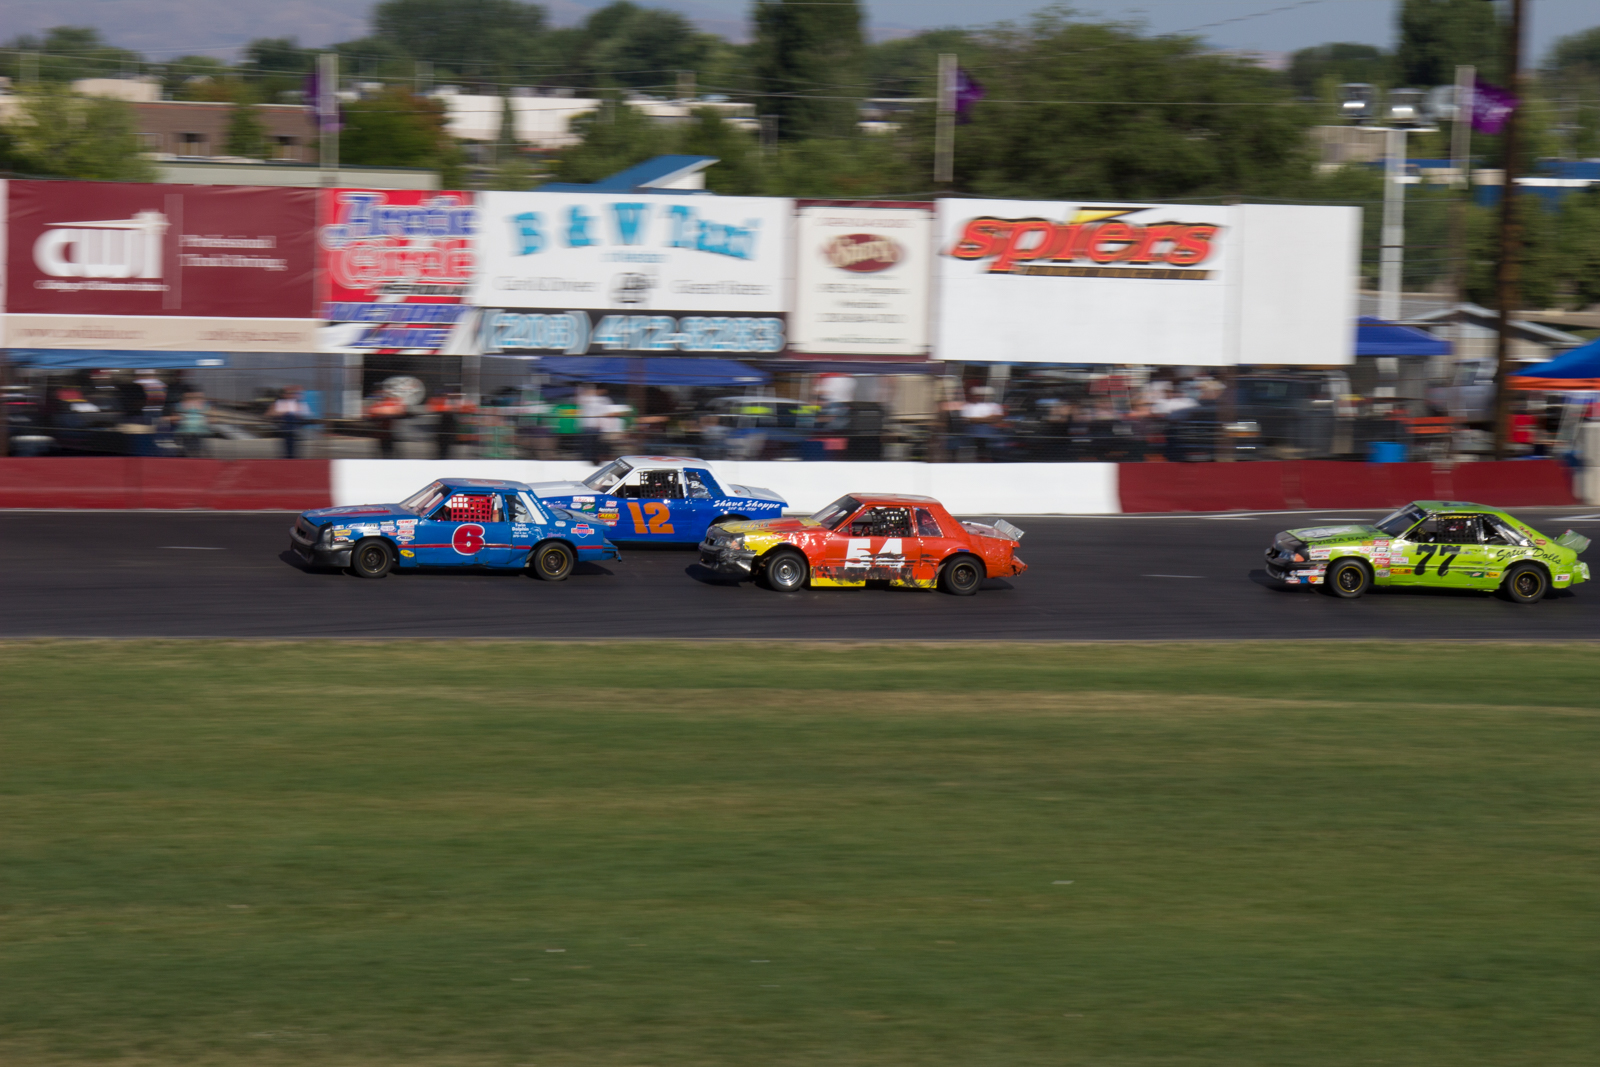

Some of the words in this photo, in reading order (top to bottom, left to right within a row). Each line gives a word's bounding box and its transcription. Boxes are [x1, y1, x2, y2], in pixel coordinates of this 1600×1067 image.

[627, 502, 675, 534] 12
[713, 499, 744, 507] Shave
[745, 500, 780, 510] Shoppe
[452, 523, 485, 556] 6
[844, 538, 905, 571] 54
[1532, 547, 1562, 564] Dolls
[1414, 543, 1461, 577] 77
